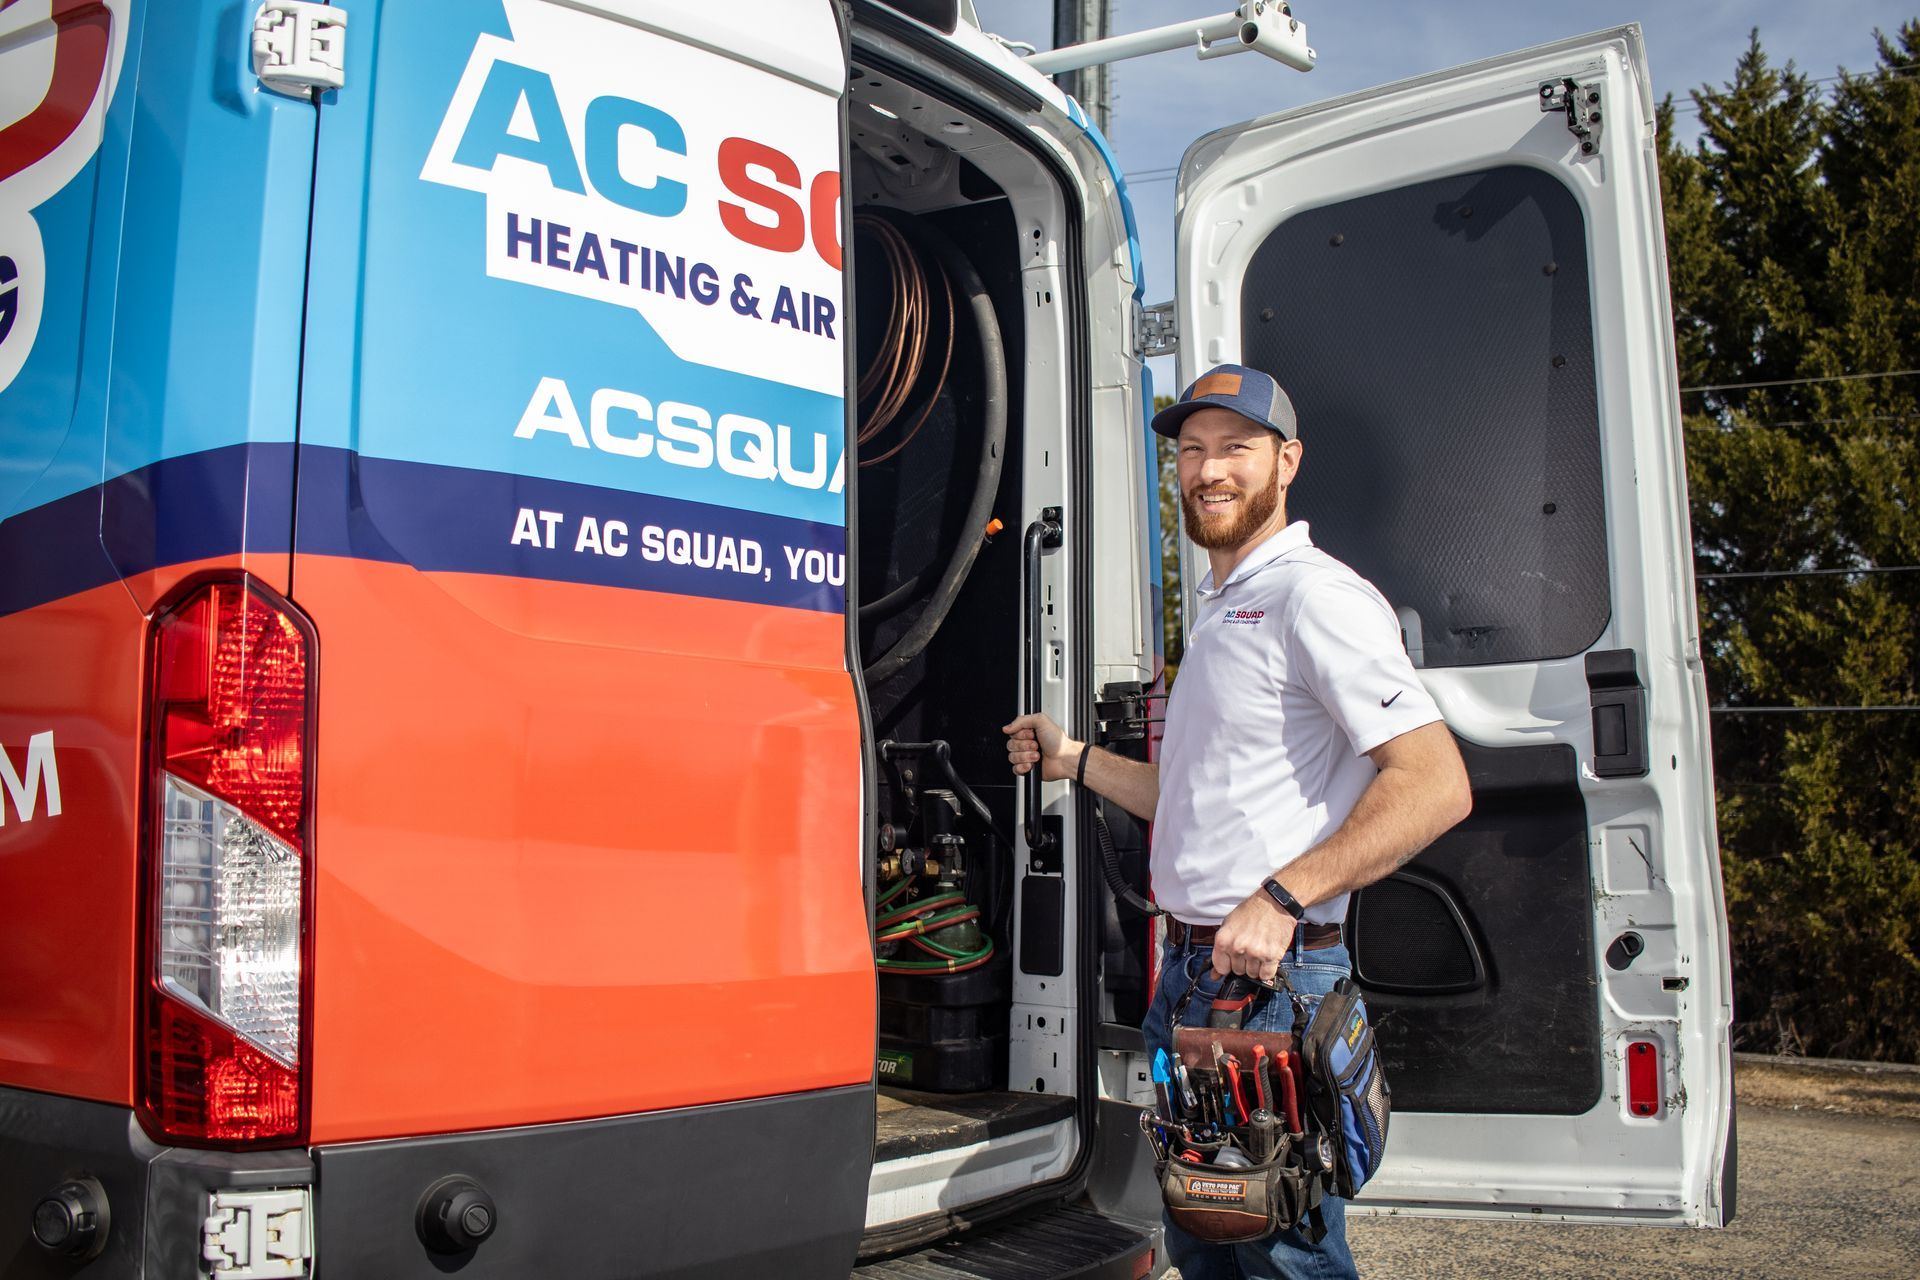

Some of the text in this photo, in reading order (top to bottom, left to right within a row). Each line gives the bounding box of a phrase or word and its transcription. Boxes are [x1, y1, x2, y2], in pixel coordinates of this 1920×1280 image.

[452, 58, 688, 218] AC
[506, 212, 836, 340] HEATING & AIR
[513, 376, 845, 494] ACSQU
[511, 507, 846, 587] AT AC SQUAD, YOU
[1235, 611, 1264, 619] SQUAD
